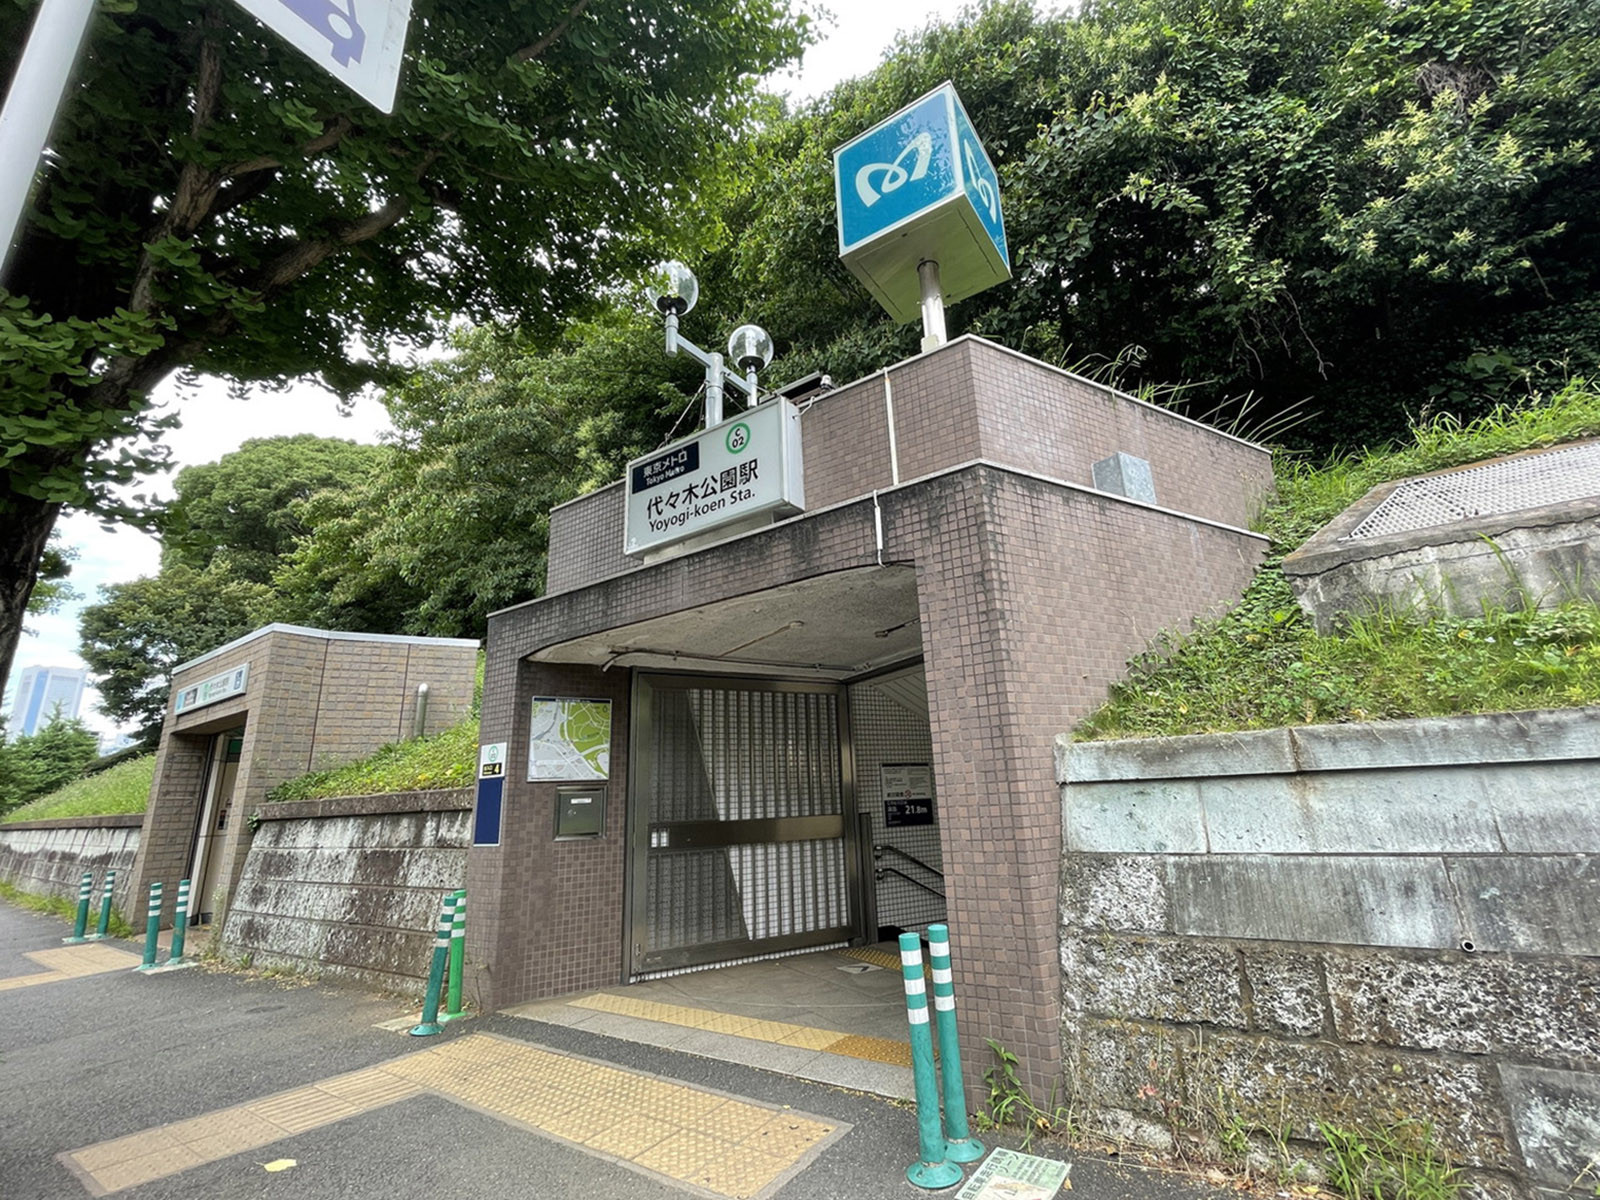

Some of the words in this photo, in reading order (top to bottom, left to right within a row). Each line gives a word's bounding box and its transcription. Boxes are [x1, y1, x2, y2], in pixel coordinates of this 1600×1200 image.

[732, 436, 744, 448] 02
[735, 428, 741, 437] C
[643, 450, 687, 478] 東京メトロ
[646, 474, 665, 485] Tokyo
[647, 458, 759, 519] 代々木公園駅
[649, 498, 725, 532] Yoyogi-koen
[730, 488, 755, 505] Sta.
